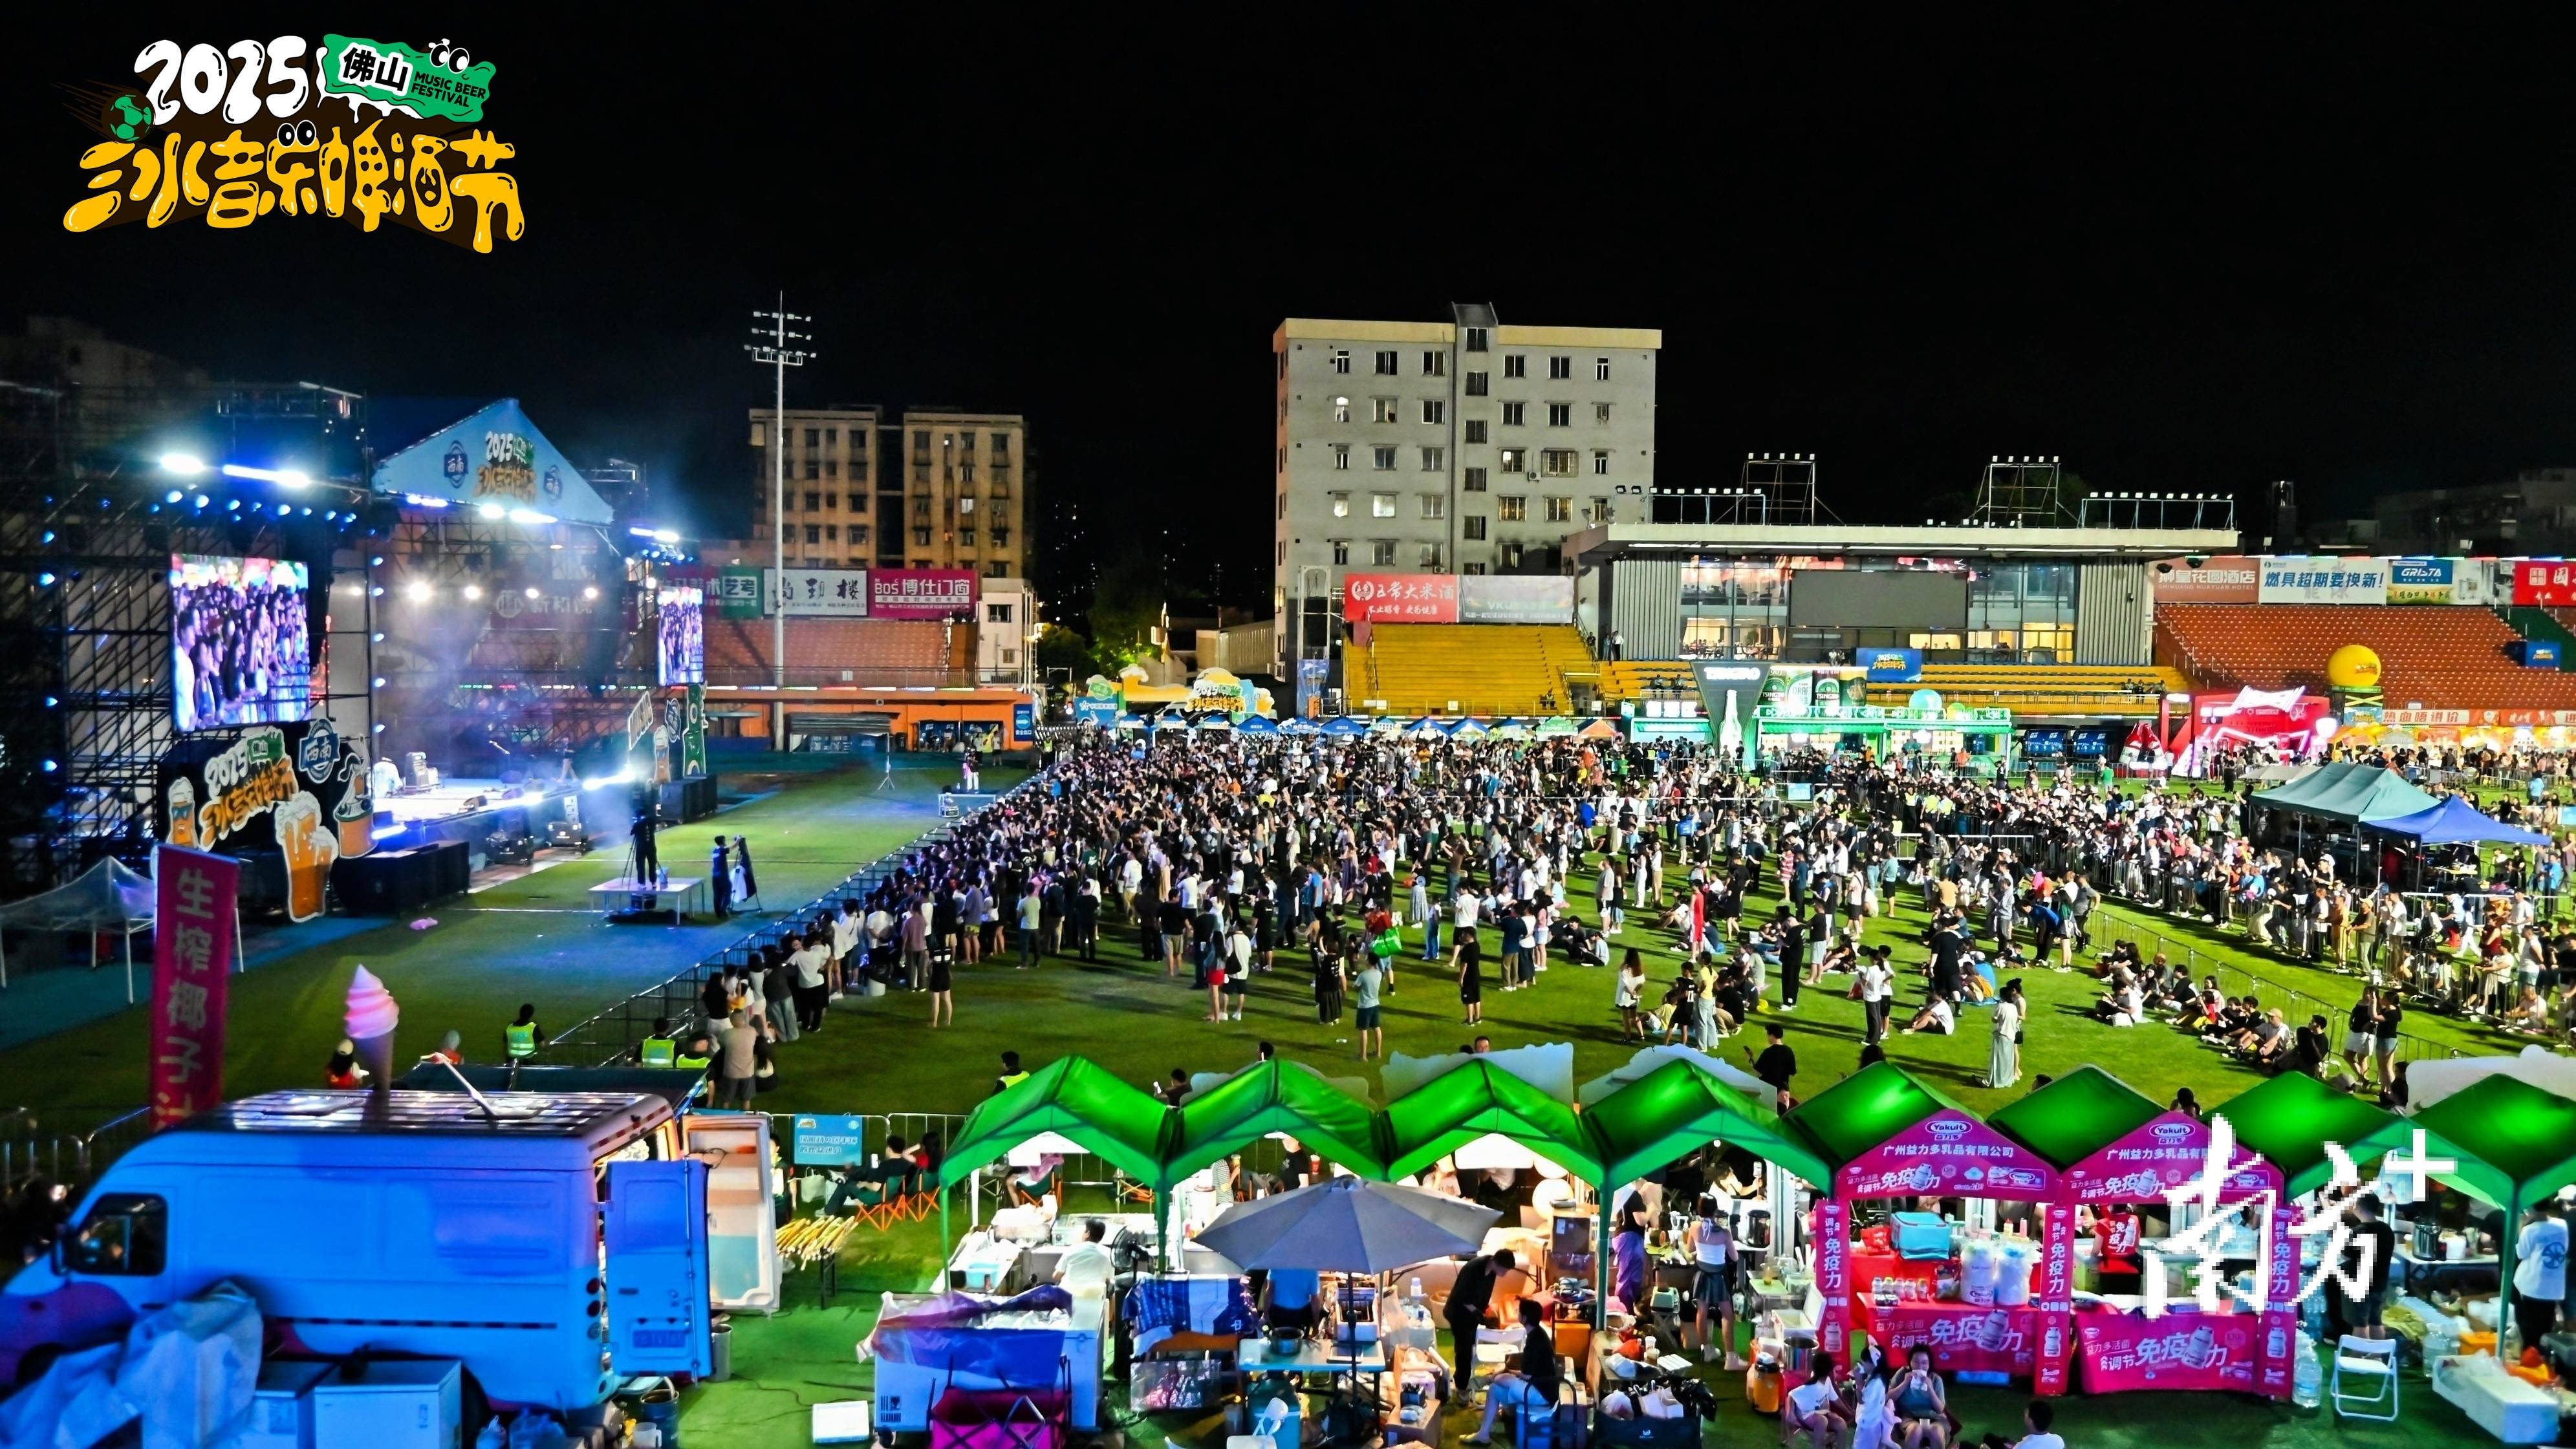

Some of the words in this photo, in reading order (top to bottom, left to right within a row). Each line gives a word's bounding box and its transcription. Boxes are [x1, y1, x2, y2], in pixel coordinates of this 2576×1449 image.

[902, 579, 970, 596] 博仕门窗
[307, 739, 332, 762] 西南
[1883, 1144, 2014, 1157] 广州益力多乳品有限公司
[1863, 1183, 1881, 1194] 调节
[1880, 1167, 1940, 1189] 免疫力
[2105, 1173, 2167, 1196] 免疫力
[1824, 1218, 1835, 1236] 调节
[2051, 1223, 2061, 1241] 调节
[2108, 1221, 2127, 1253] 免疫力
[2275, 1222, 2286, 1241] 调节
[1824, 1238, 1841, 1289] 免疫力
[2048, 1243, 2065, 1294] 免疫力
[2271, 1242, 2291, 1294] 免疫力
[1928, 1315, 2024, 1352] 免疫力
[2086, 1339, 2131, 1355] 益力多活菌
[2108, 1354, 2136, 1371] 调节
[2134, 1331, 2227, 1368] 免疫力
